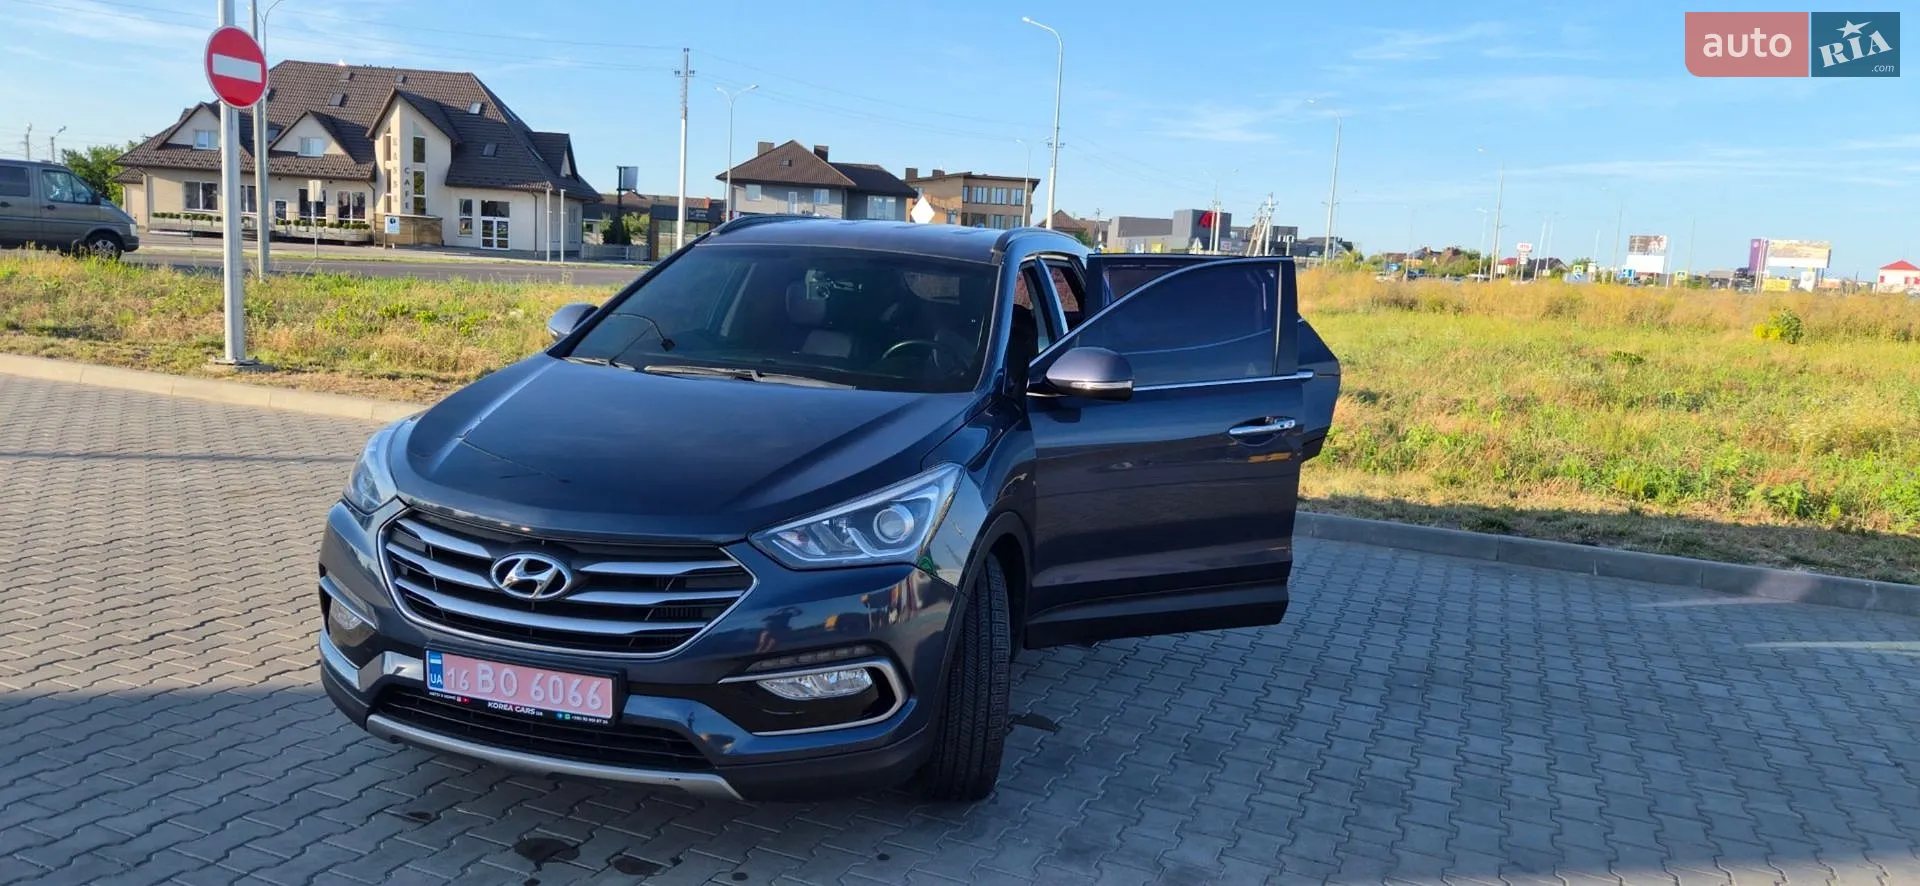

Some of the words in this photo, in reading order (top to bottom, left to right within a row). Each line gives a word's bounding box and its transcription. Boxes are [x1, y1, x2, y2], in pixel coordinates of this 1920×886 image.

[430, 673, 443, 685] UA
[447, 668, 470, 691] 16
[477, 663, 518, 697] BO
[530, 672, 602, 710] 6066
[487, 701, 513, 712] KOREA
[515, 706, 536, 715] CARS
